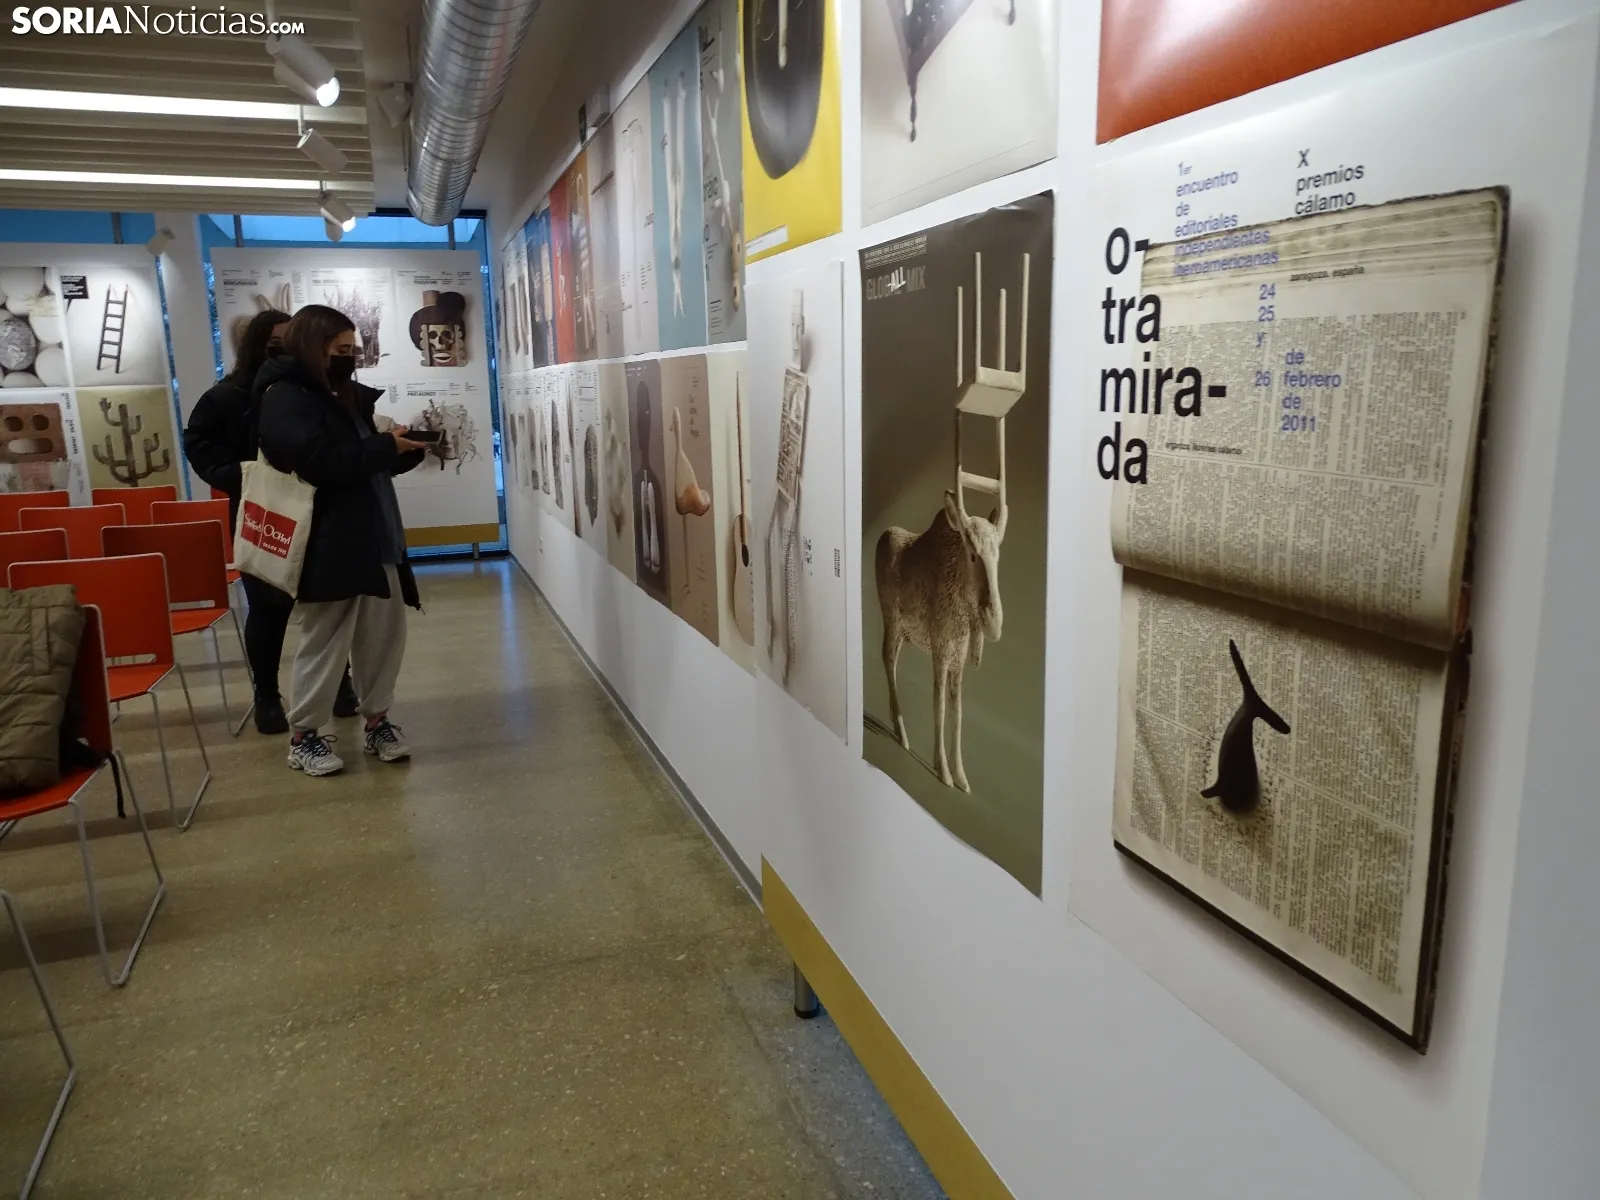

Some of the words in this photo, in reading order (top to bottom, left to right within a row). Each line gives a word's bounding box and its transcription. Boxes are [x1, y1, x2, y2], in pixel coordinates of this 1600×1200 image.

[1296, 148, 1310, 168] X
[1176, 171, 1238, 197] encuentro
[1296, 164, 1365, 196] premios
[1175, 201, 1190, 217] de
[1295, 191, 1356, 214] cálamo
[1174, 212, 1238, 237] editoriales
[1174, 230, 1270, 256] independientes
[1173, 251, 1279, 277] iberoamericanas
[1259, 283, 1276, 300] 24
[1101, 287, 1161, 344] tra
[1258, 305, 1275, 322] 25
[1285, 349, 1305, 365] de
[1100, 351, 1227, 417] mira-
[1255, 371, 1271, 387] 26
[1284, 370, 1342, 388] febrero
[1282, 392, 1302, 409] de
[1281, 415, 1316, 432] 2011
[1097, 421, 1148, 485] da
